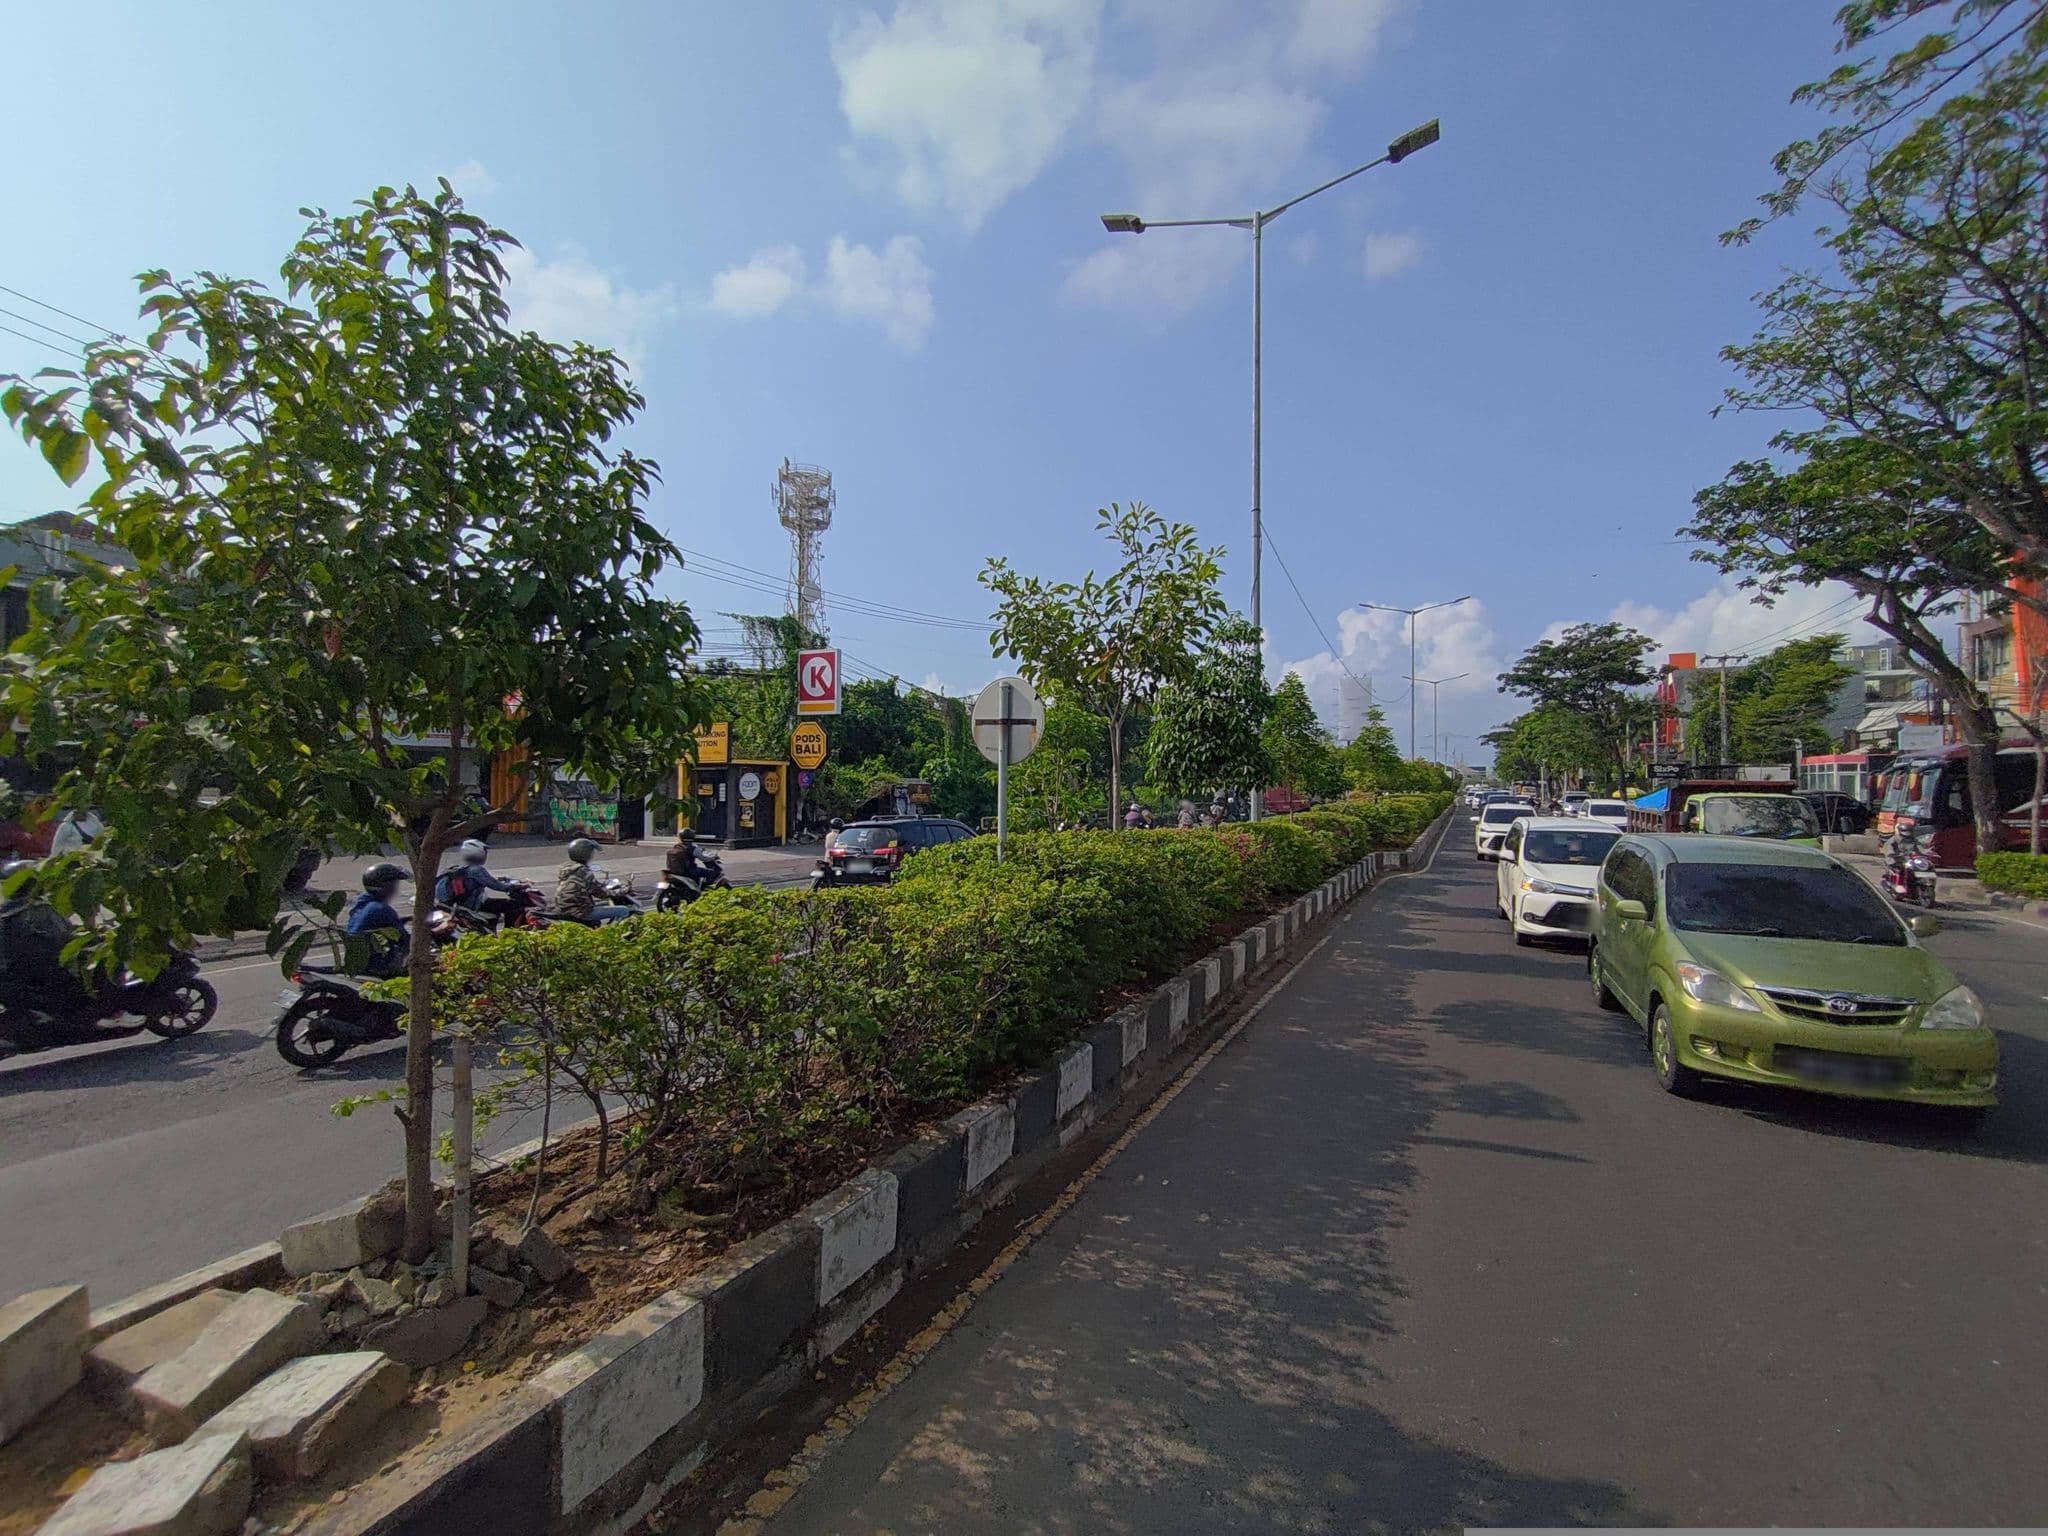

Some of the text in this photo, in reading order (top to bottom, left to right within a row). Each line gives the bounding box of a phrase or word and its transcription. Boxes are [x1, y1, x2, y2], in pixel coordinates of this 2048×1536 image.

[810, 665, 829, 692] K
[795, 734, 821, 743] PODS
[795, 744, 821, 754] BALI
